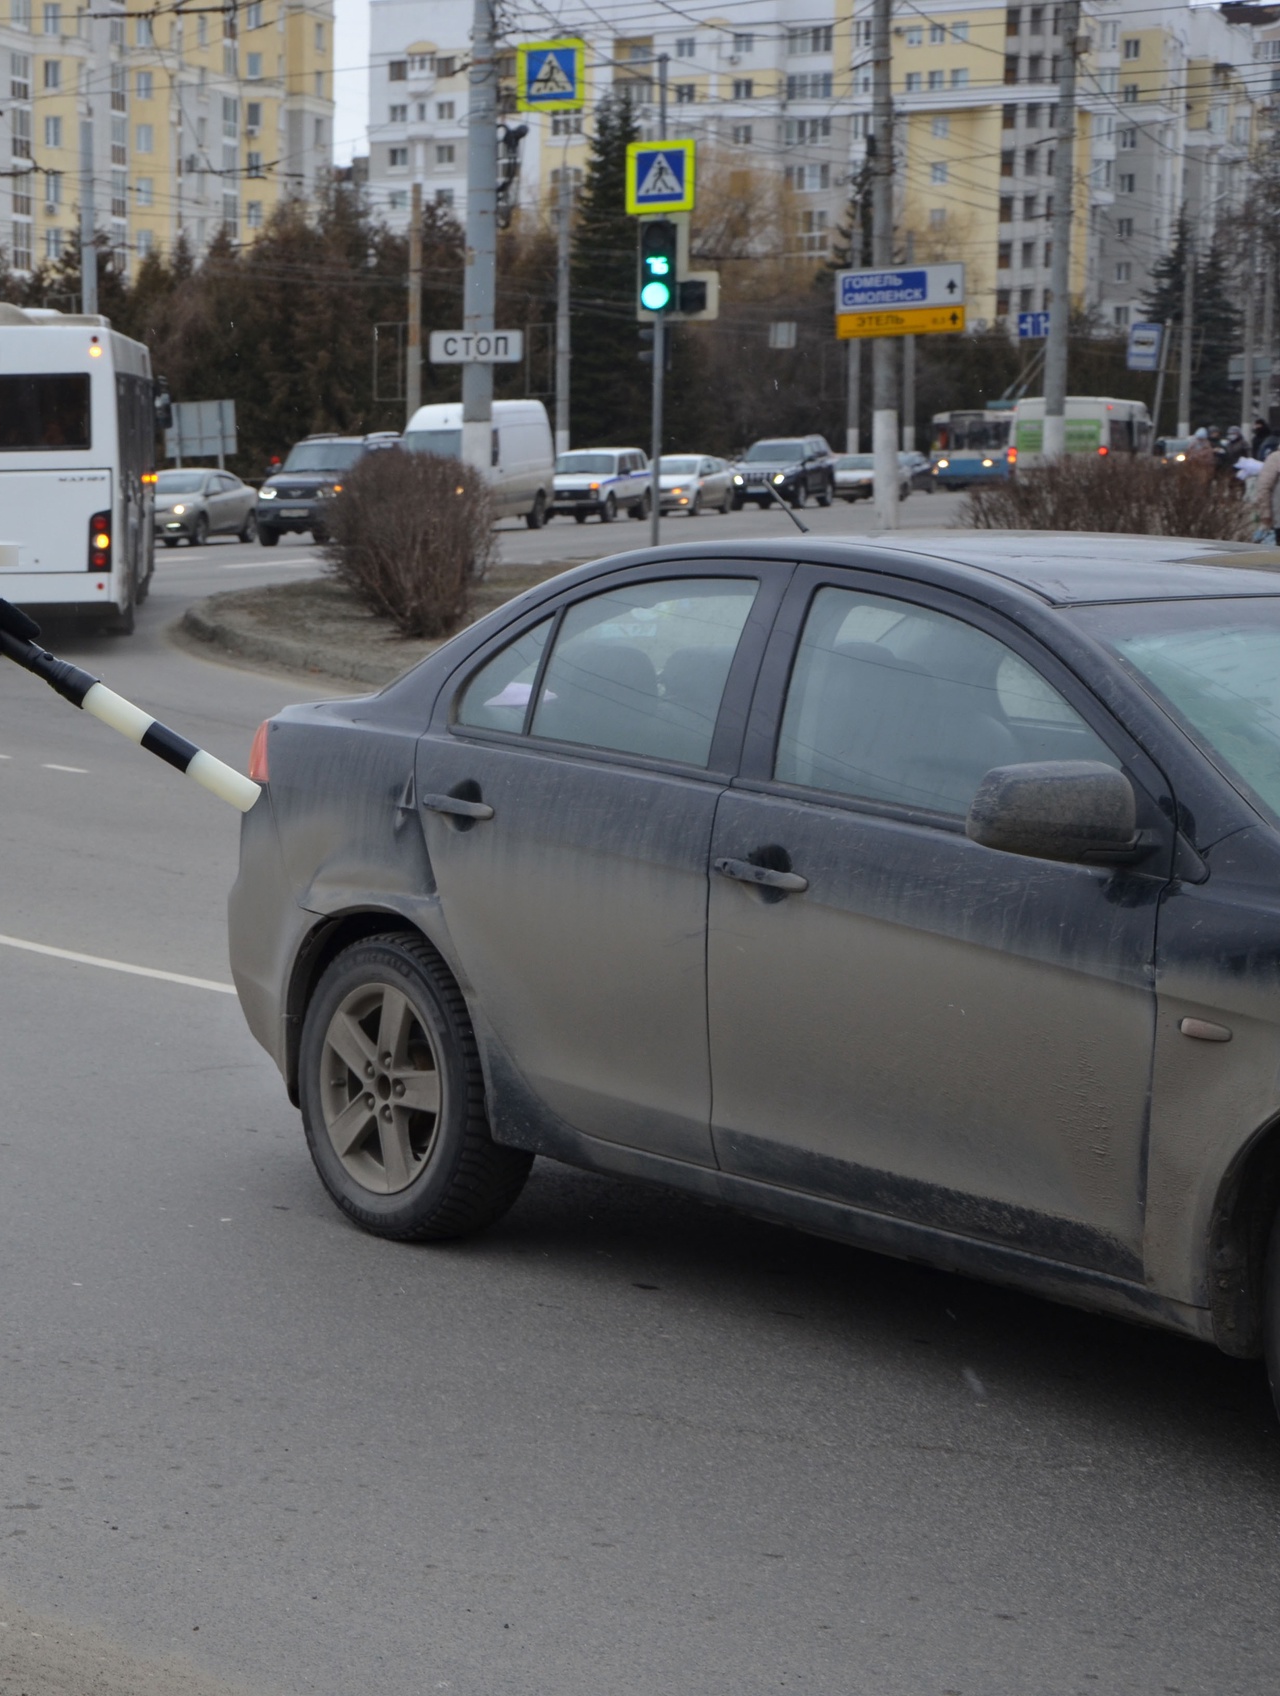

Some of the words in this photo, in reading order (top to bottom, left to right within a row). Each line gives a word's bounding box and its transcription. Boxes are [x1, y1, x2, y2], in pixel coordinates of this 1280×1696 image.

[844, 275, 903, 290] ГОМЕЛЬ
[844, 289, 924, 305] СМОЛЕНСК
[443, 336, 508, 356] СТОП
